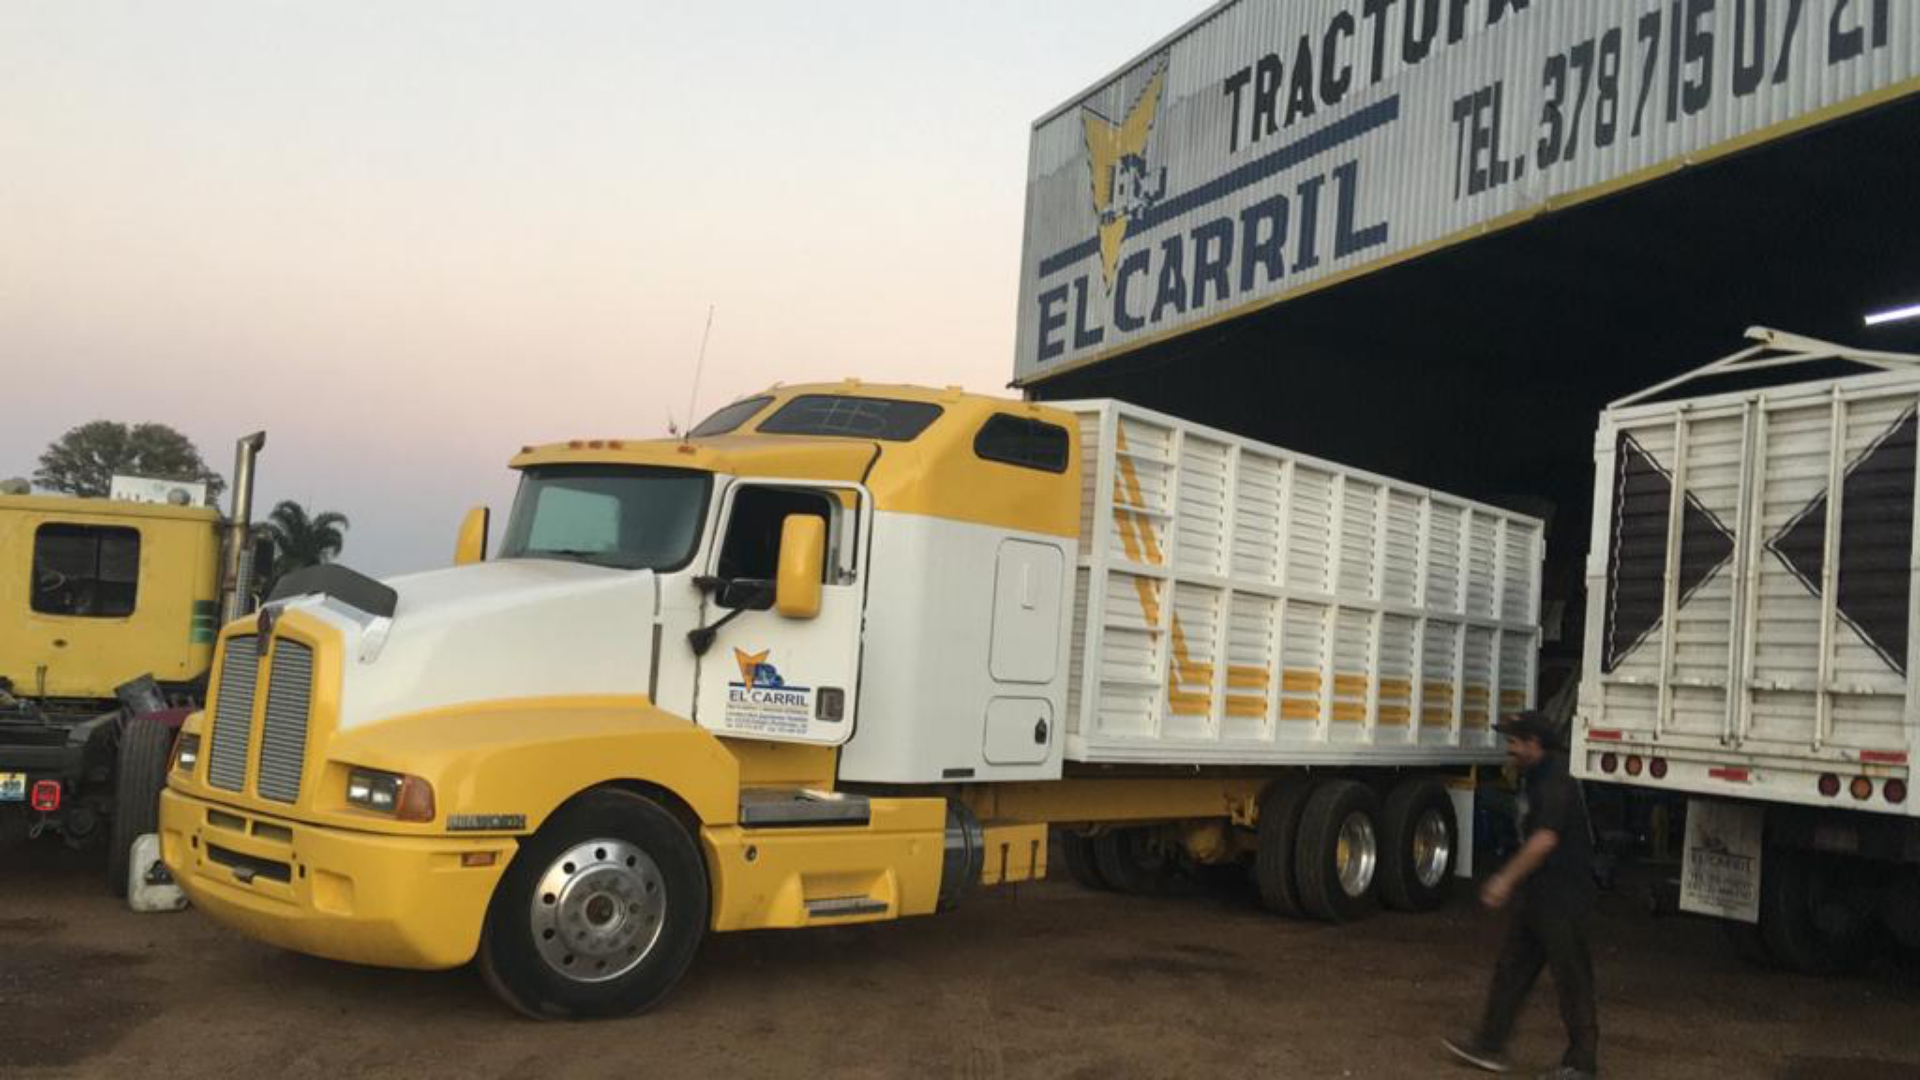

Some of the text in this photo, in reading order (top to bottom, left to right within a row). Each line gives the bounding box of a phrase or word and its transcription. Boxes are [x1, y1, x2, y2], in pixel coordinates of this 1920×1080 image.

[1224, 0, 1529, 154] TRACTO
[1453, 81, 1525, 200] TEL.
[1537, 28, 1621, 170] 378
[1631, 0, 1714, 137] 715
[1038, 160, 1388, 362] EL CARRIL
[729, 690, 809, 708] EL CARRIL
